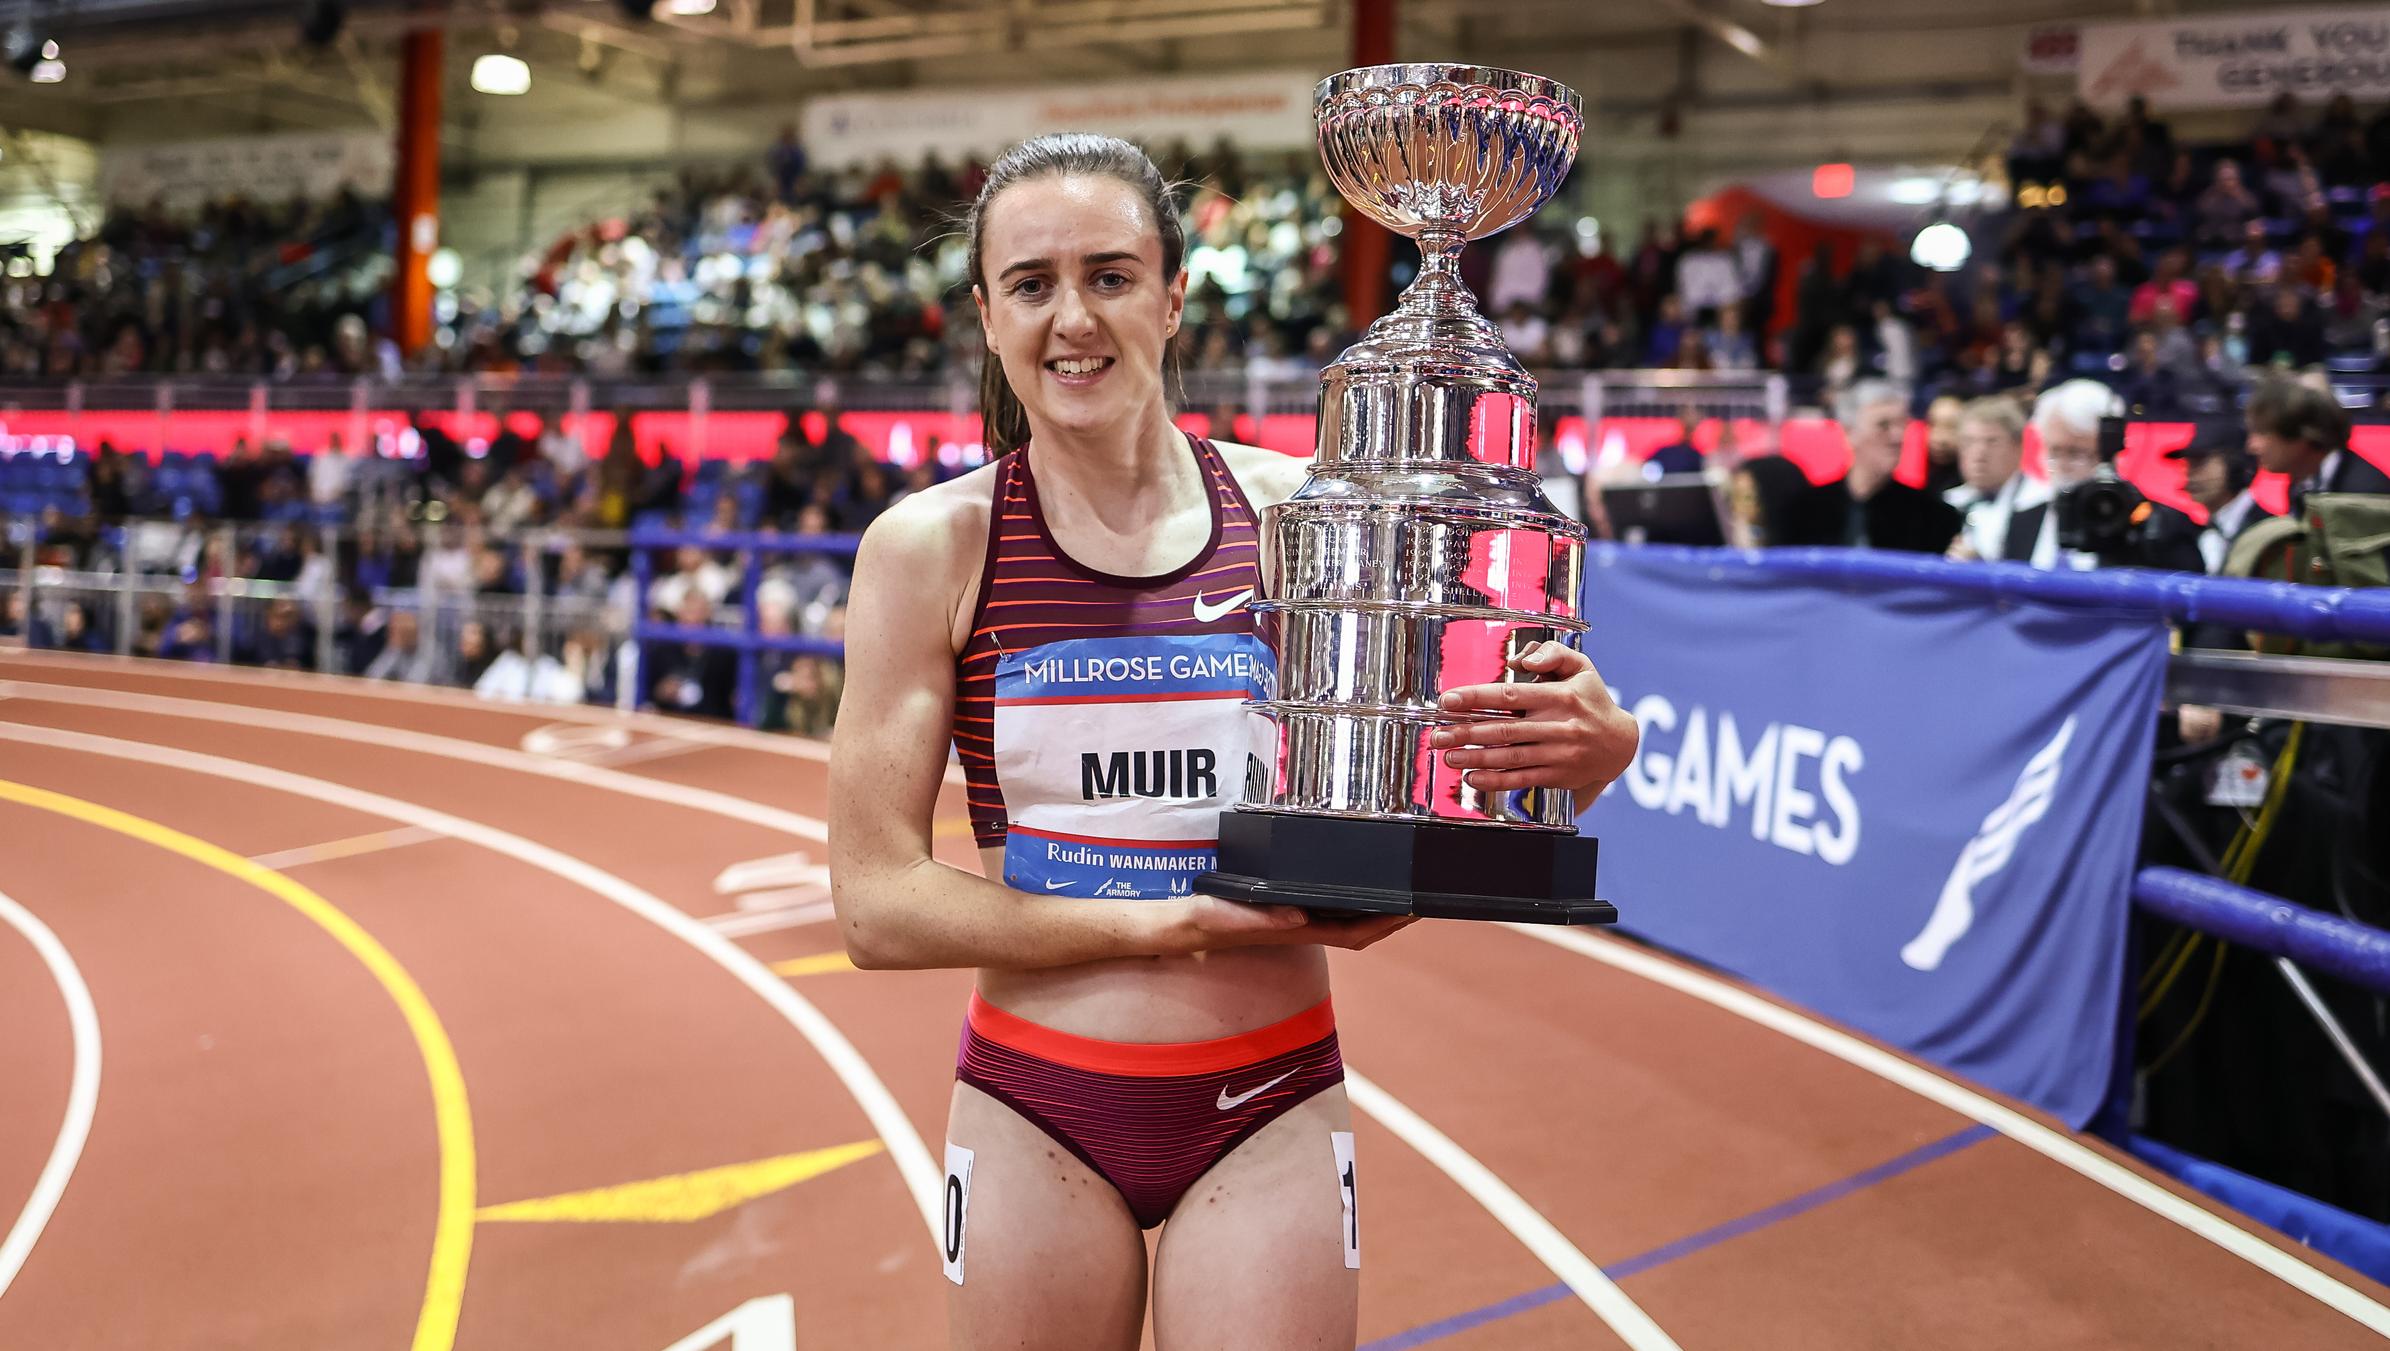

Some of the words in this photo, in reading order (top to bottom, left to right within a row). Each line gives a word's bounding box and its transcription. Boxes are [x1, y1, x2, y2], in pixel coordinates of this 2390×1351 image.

[1024, 656, 1163, 684] MILLROSE
[1081, 748, 1217, 800] MUIR
[1623, 694, 1865, 866] GAMES
[1109, 854, 1206, 871] WANAMAKER
[1106, 889, 1141, 897] ARMORY
[946, 1174, 963, 1264] 0
[1342, 1160, 1357, 1250] 1
